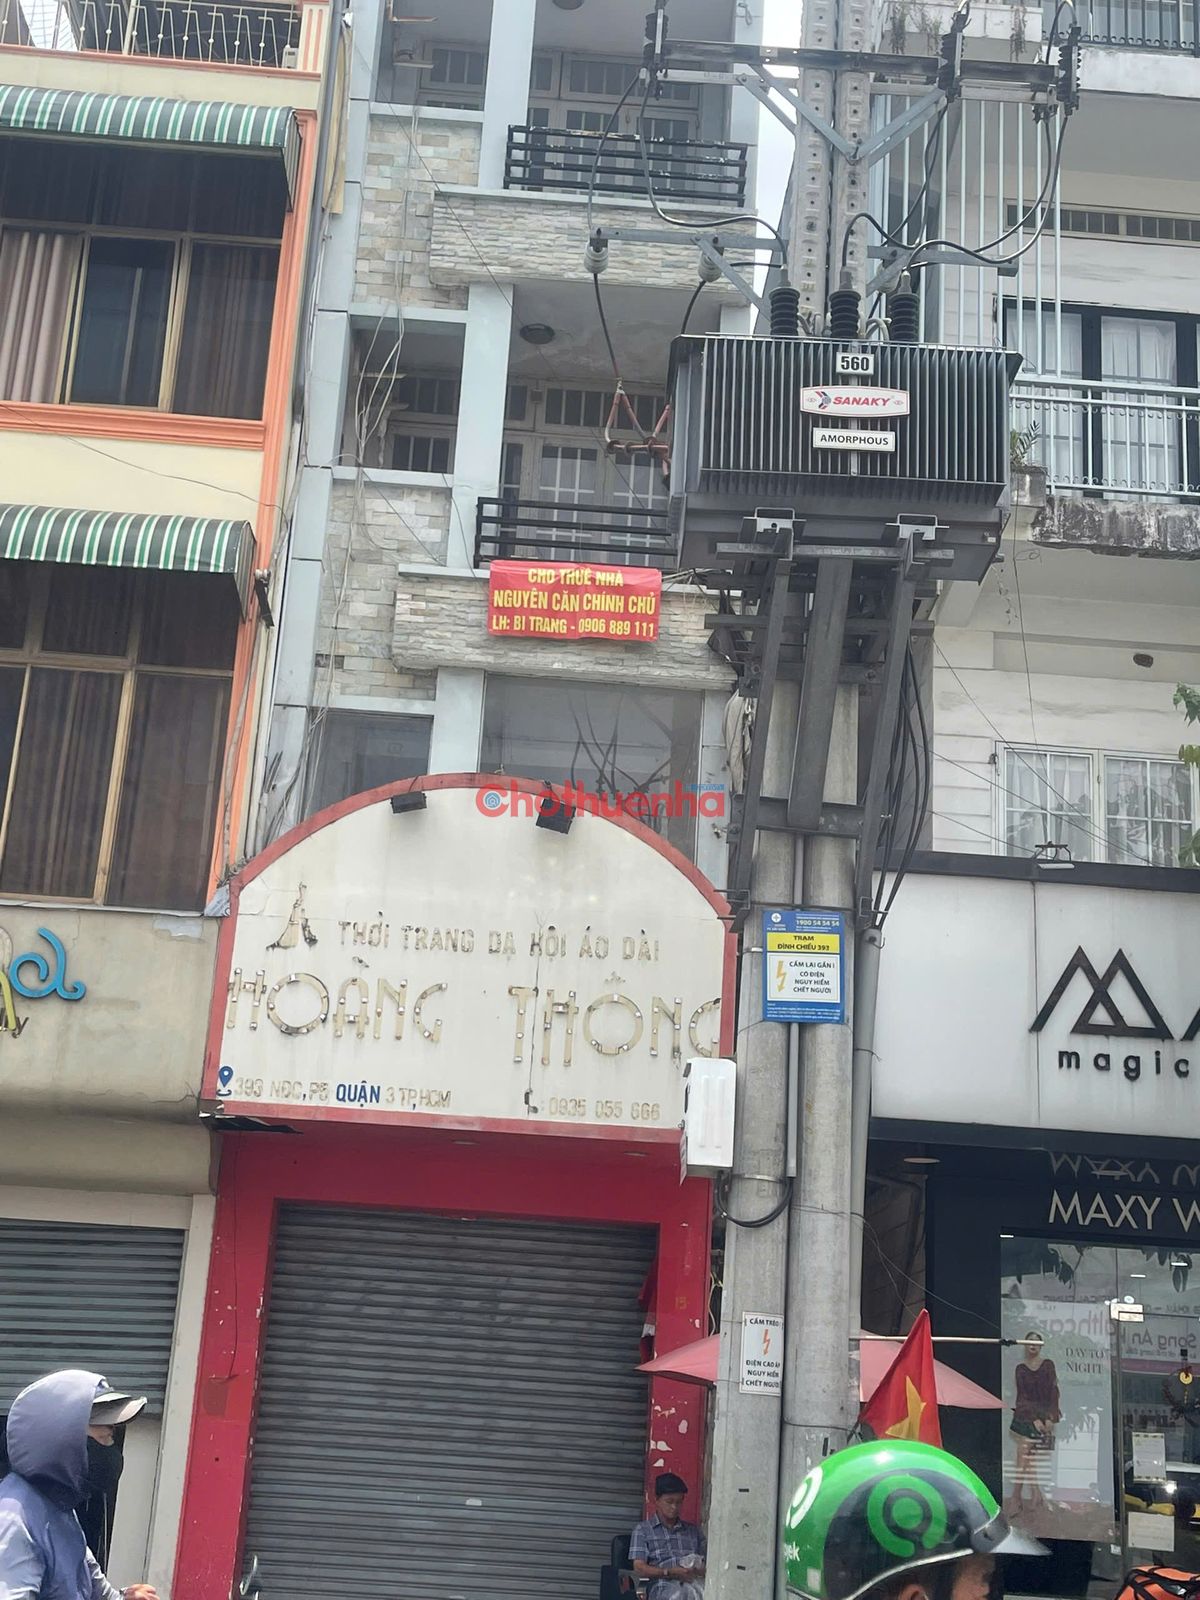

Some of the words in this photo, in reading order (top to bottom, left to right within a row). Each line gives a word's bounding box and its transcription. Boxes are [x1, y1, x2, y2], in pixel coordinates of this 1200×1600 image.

[841, 355, 870, 371] 560
[833, 396, 890, 406] SANAKY
[820, 434, 889, 445] AMORPHOUS
[528, 568, 556, 584] CHO
[559, 567, 592, 586] THUÊ
[595, 569, 624, 587] NHÀ
[493, 589, 548, 610] NGUYÊN
[552, 590, 579, 612] CĂN
[583, 590, 624, 613] CHÍNH
[628, 592, 656, 615] CHỦ
[492, 615, 510, 631] LH:
[513, 616, 525, 631] BI
[529, 615, 567, 634] TRANG
[578, 617, 606, 633] 0906
[609, 619, 630, 635] 889
[634, 621, 654, 637] 111
[401, 925, 475, 953] TRANG
[579, 925, 609, 960] ÁO
[622, 929, 659, 961] DÀI
[227, 956, 448, 1044] HOÀNG
[1058, 1050, 1190, 1082] magic
[336, 1080, 380, 1107] QUẬN
[386, 1086, 395, 1104] 3
[595, 1099, 623, 1119] 055
[630, 1102, 661, 1121] 666
[1049, 1189, 1161, 1230] MAXY
[749, 1318, 765, 1326] CẤM
[1066, 1348, 1087, 1358] DAY
[1089, 1349, 1104, 1359] TO
[747, 1369, 766, 1377] NGUY
[762, 1360, 774, 1368] CAO
[1066, 1362, 1104, 1374] NIGHT
[745, 1379, 762, 1387] CHẾT
